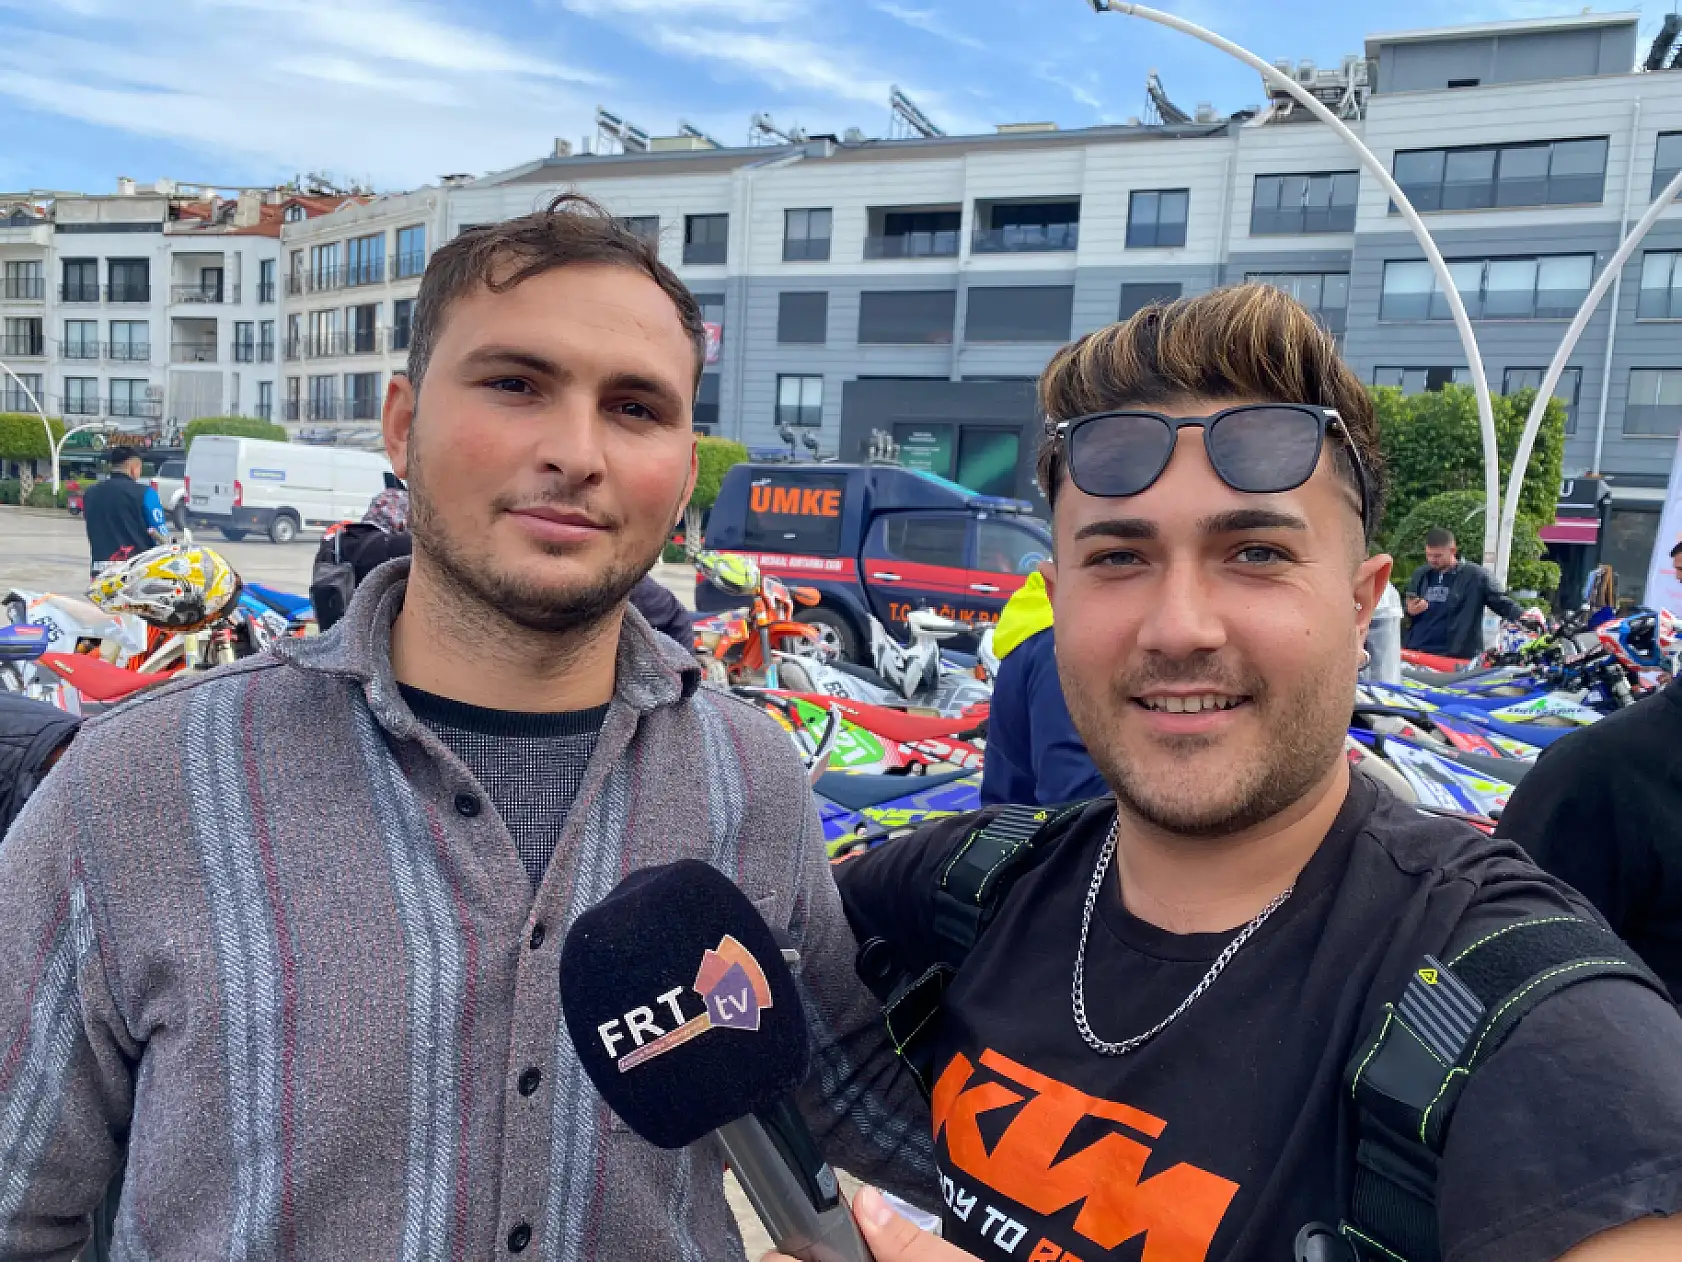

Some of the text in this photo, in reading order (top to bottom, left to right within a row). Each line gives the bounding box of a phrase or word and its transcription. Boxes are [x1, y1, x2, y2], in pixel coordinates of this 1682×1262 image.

[598, 985, 686, 1059] FRT
[714, 987, 749, 1021] tv
[931, 1047, 1241, 1262] KTM
[937, 1165, 978, 1223] DY
[980, 1204, 1030, 1255] TO
